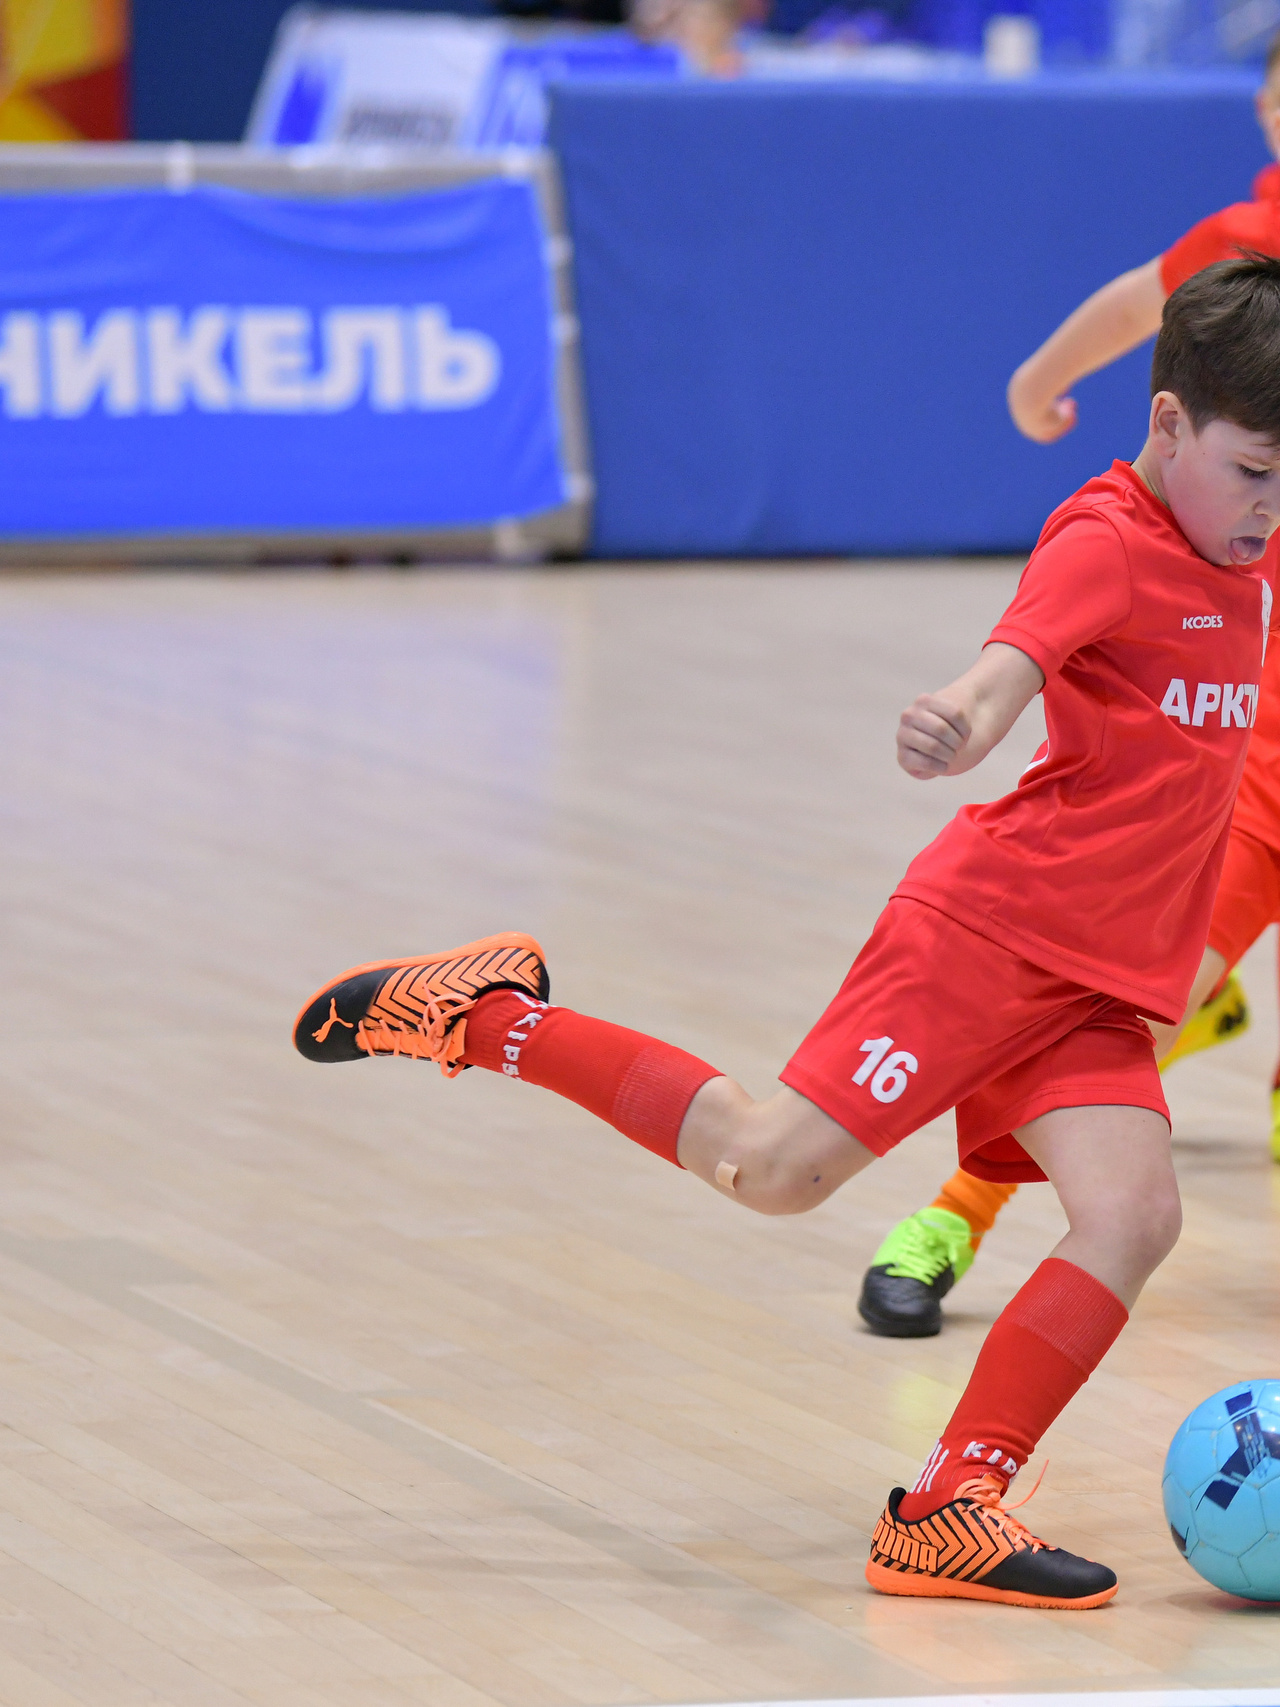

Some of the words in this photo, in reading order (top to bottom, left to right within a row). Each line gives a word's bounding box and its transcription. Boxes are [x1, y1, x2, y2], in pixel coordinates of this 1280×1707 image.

[1182, 615, 1223, 630] KODES
[502, 1012, 543, 1080] KIPS
[851, 1036, 919, 1104] 16
[962, 1441, 1019, 1487] KIP
[872, 1517, 939, 1573] PUMA
